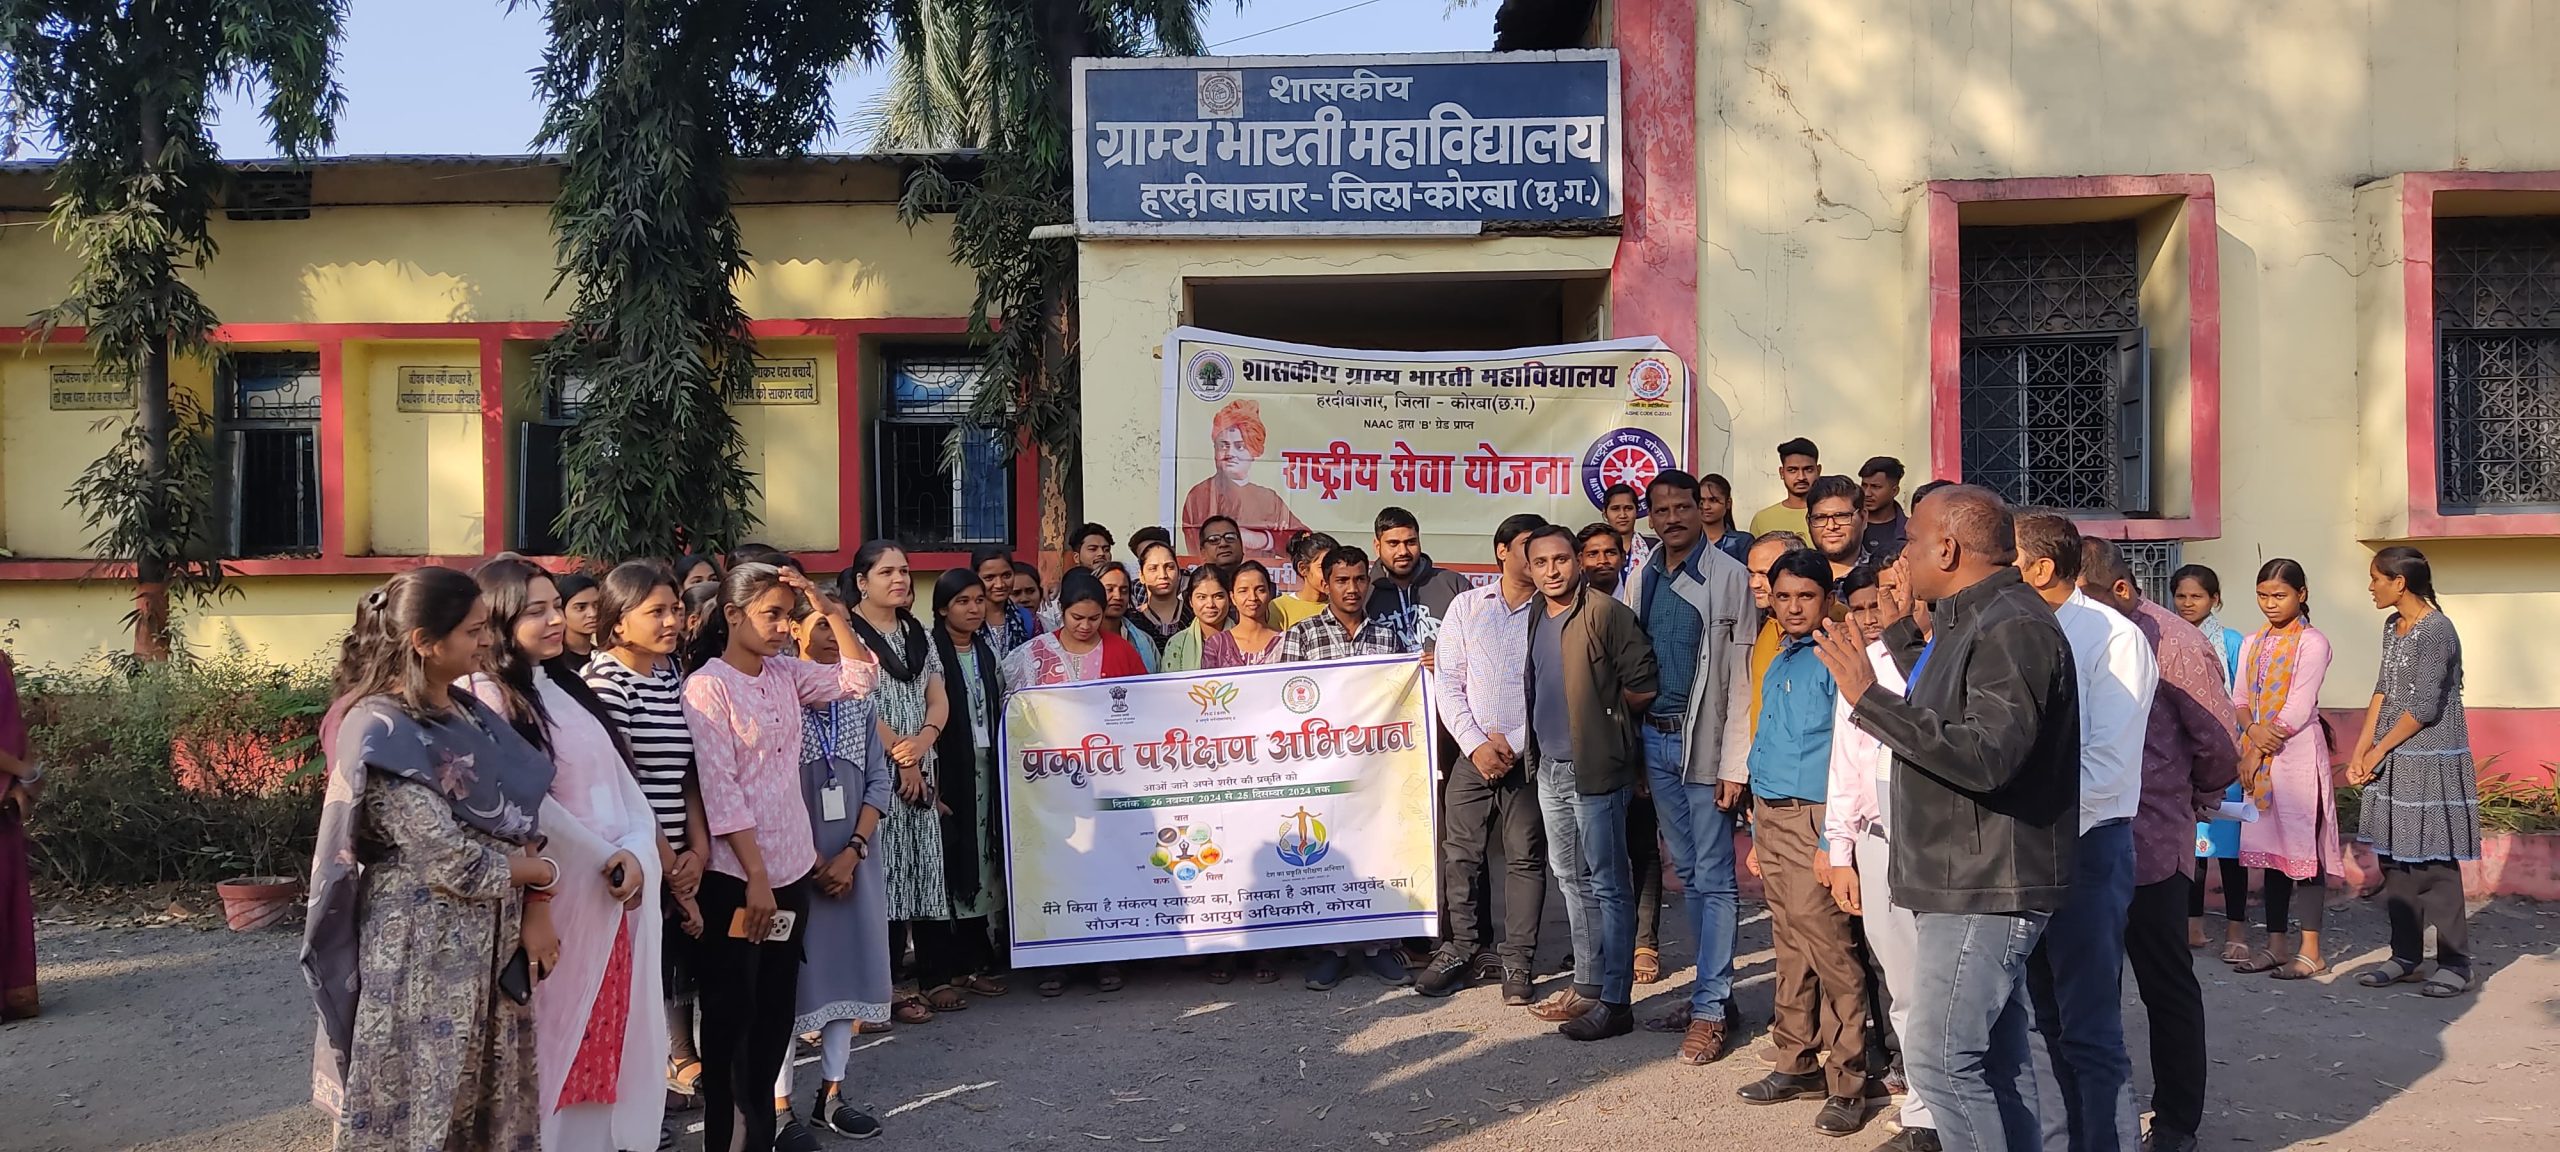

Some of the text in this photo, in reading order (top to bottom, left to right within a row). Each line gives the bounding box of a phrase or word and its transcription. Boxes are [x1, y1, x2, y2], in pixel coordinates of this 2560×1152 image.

[1268, 68, 1414, 103] शासकीय
[1095, 101, 1605, 170] ग्राम्य भारती महाविद्यालय
[1242, 358, 1339, 384] शासकीय
[1345, 367, 1402, 386] ग्राम्य
[1408, 366, 1475, 388] भारती
[1394, 391, 1431, 409] जिला
[1363, 419, 1394, 429] NAAC
[1435, 416, 1450, 430] ग्रेड
[1617, 432, 1641, 444] सेवा
[1644, 438, 1669, 468] योजना
[1281, 441, 1575, 500] राष्ट्रीय सेवा योजना
[1020, 717, 1415, 786] प्रकृति परीक्षण अभियान
[1150, 798, 1162, 807] 26
[1198, 794, 1221, 802] 2024
[1224, 791, 1233, 800] से
[1237, 791, 1249, 800] 25
[1288, 787, 1311, 796] 2024
[1314, 785, 1331, 794] तक
[1171, 779, 1189, 790] जाने
[1193, 777, 1214, 788] अपने
[1217, 776, 1238, 786] शरीर
[1241, 775, 1253, 785] की
[1257, 773, 1281, 786] प्रकृति
[1285, 771, 1298, 781] को
[1067, 900, 1098, 914] किया
[1103, 898, 1112, 912] है
[1117, 897, 1158, 910] संकल्प
[1163, 894, 1205, 908] स्वास्थ्य
[1238, 888, 1280, 902] जिसका
[1286, 884, 1294, 899] है
[1300, 883, 1336, 897] आधार
[1342, 876, 1385, 894] आयुर्वेद
[1085, 916, 1140, 931] सौजन्य
[1155, 912, 1195, 927] जिला
[1200, 909, 1243, 924] आयुष
